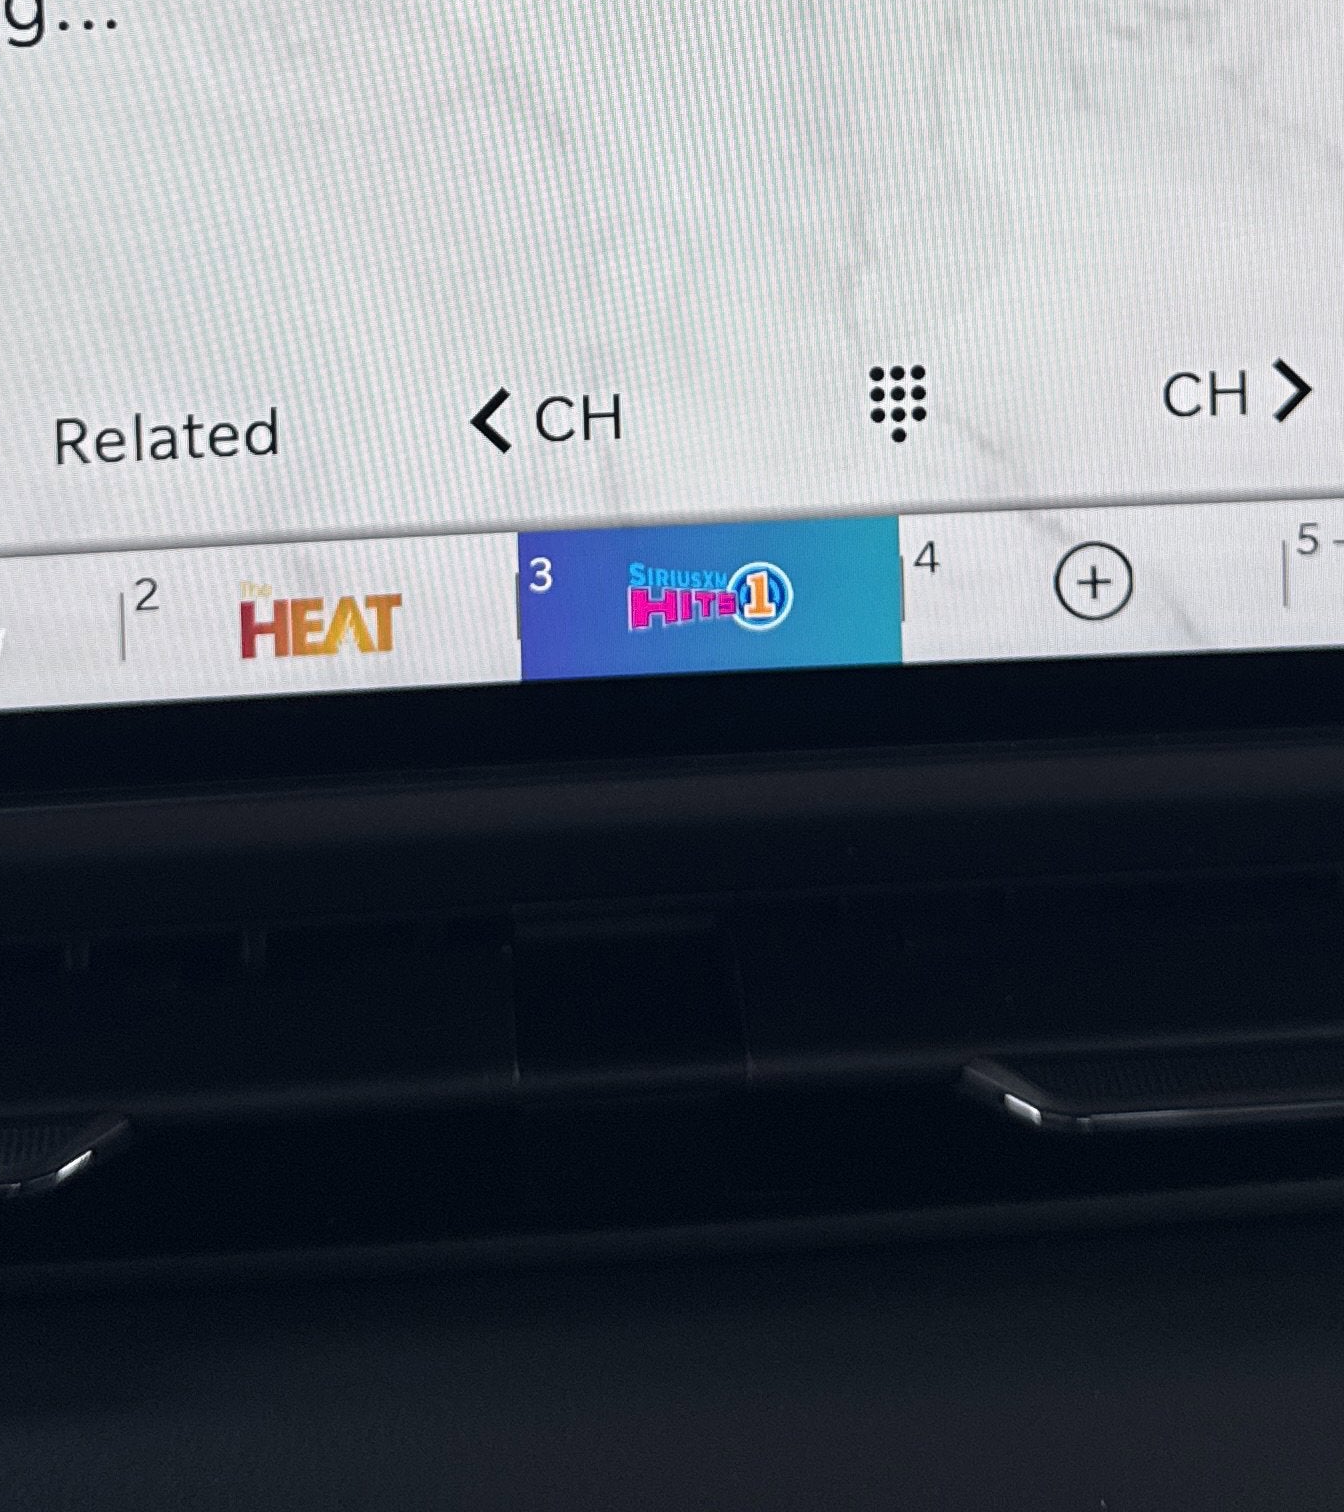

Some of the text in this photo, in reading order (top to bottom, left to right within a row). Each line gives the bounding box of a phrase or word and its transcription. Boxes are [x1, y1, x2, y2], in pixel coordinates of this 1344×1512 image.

[535, 393, 623, 441] CH
[1163, 369, 1248, 417] CH
[55, 407, 279, 465] Related
[914, 540, 940, 575] 4
[1296, 521, 1319, 556] 5
[134, 577, 160, 611] 2
[529, 557, 553, 593] 3
[744, 570, 776, 619] 1
[240, 592, 403, 659] HEAT
